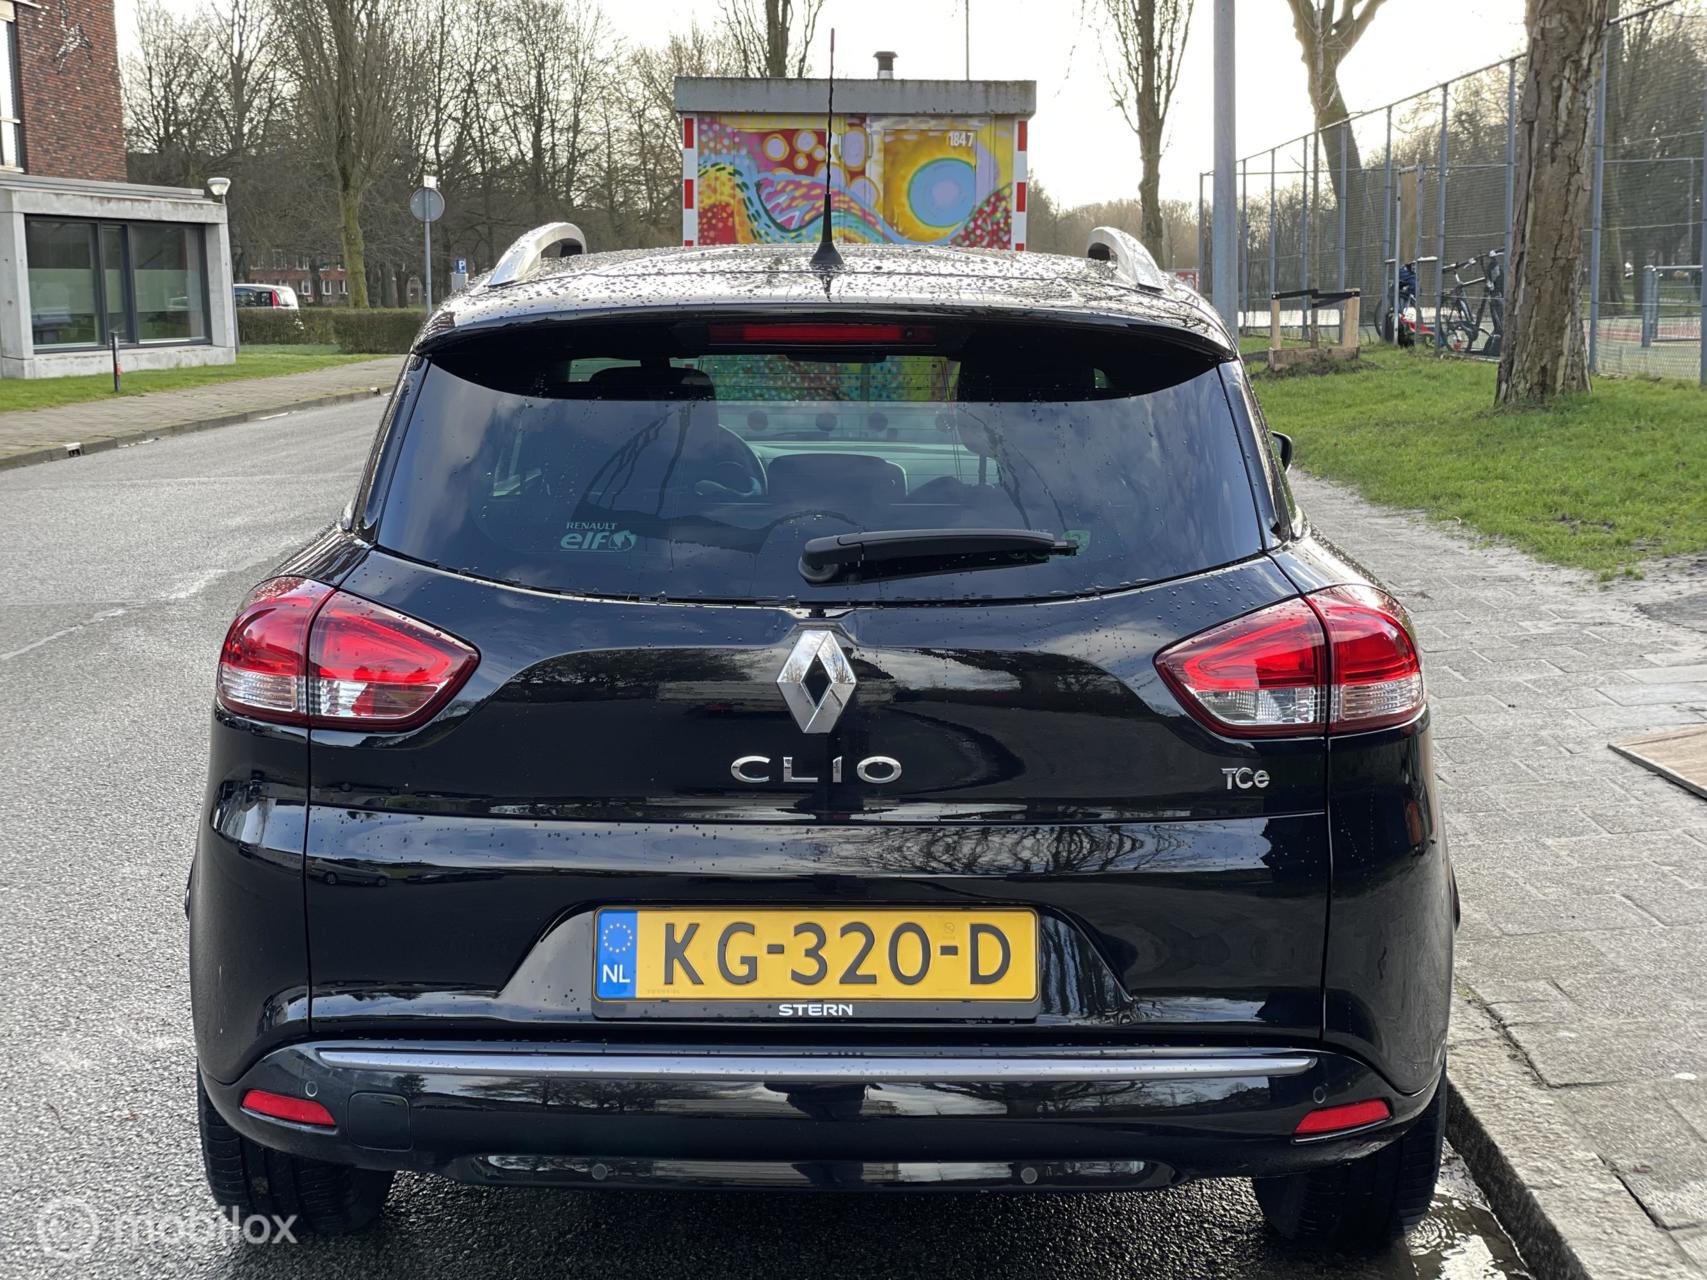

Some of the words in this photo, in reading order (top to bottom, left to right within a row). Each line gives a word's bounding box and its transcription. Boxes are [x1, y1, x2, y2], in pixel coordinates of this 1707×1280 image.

[566, 521, 618, 530] RENAULT
[560, 531, 610, 550] elf
[730, 755, 902, 784] CLIO
[1220, 767, 1271, 790] TCe
[663, 921, 1012, 985] KG-320-D
[602, 963, 631, 984] NL
[778, 1003, 853, 1017] STERN
